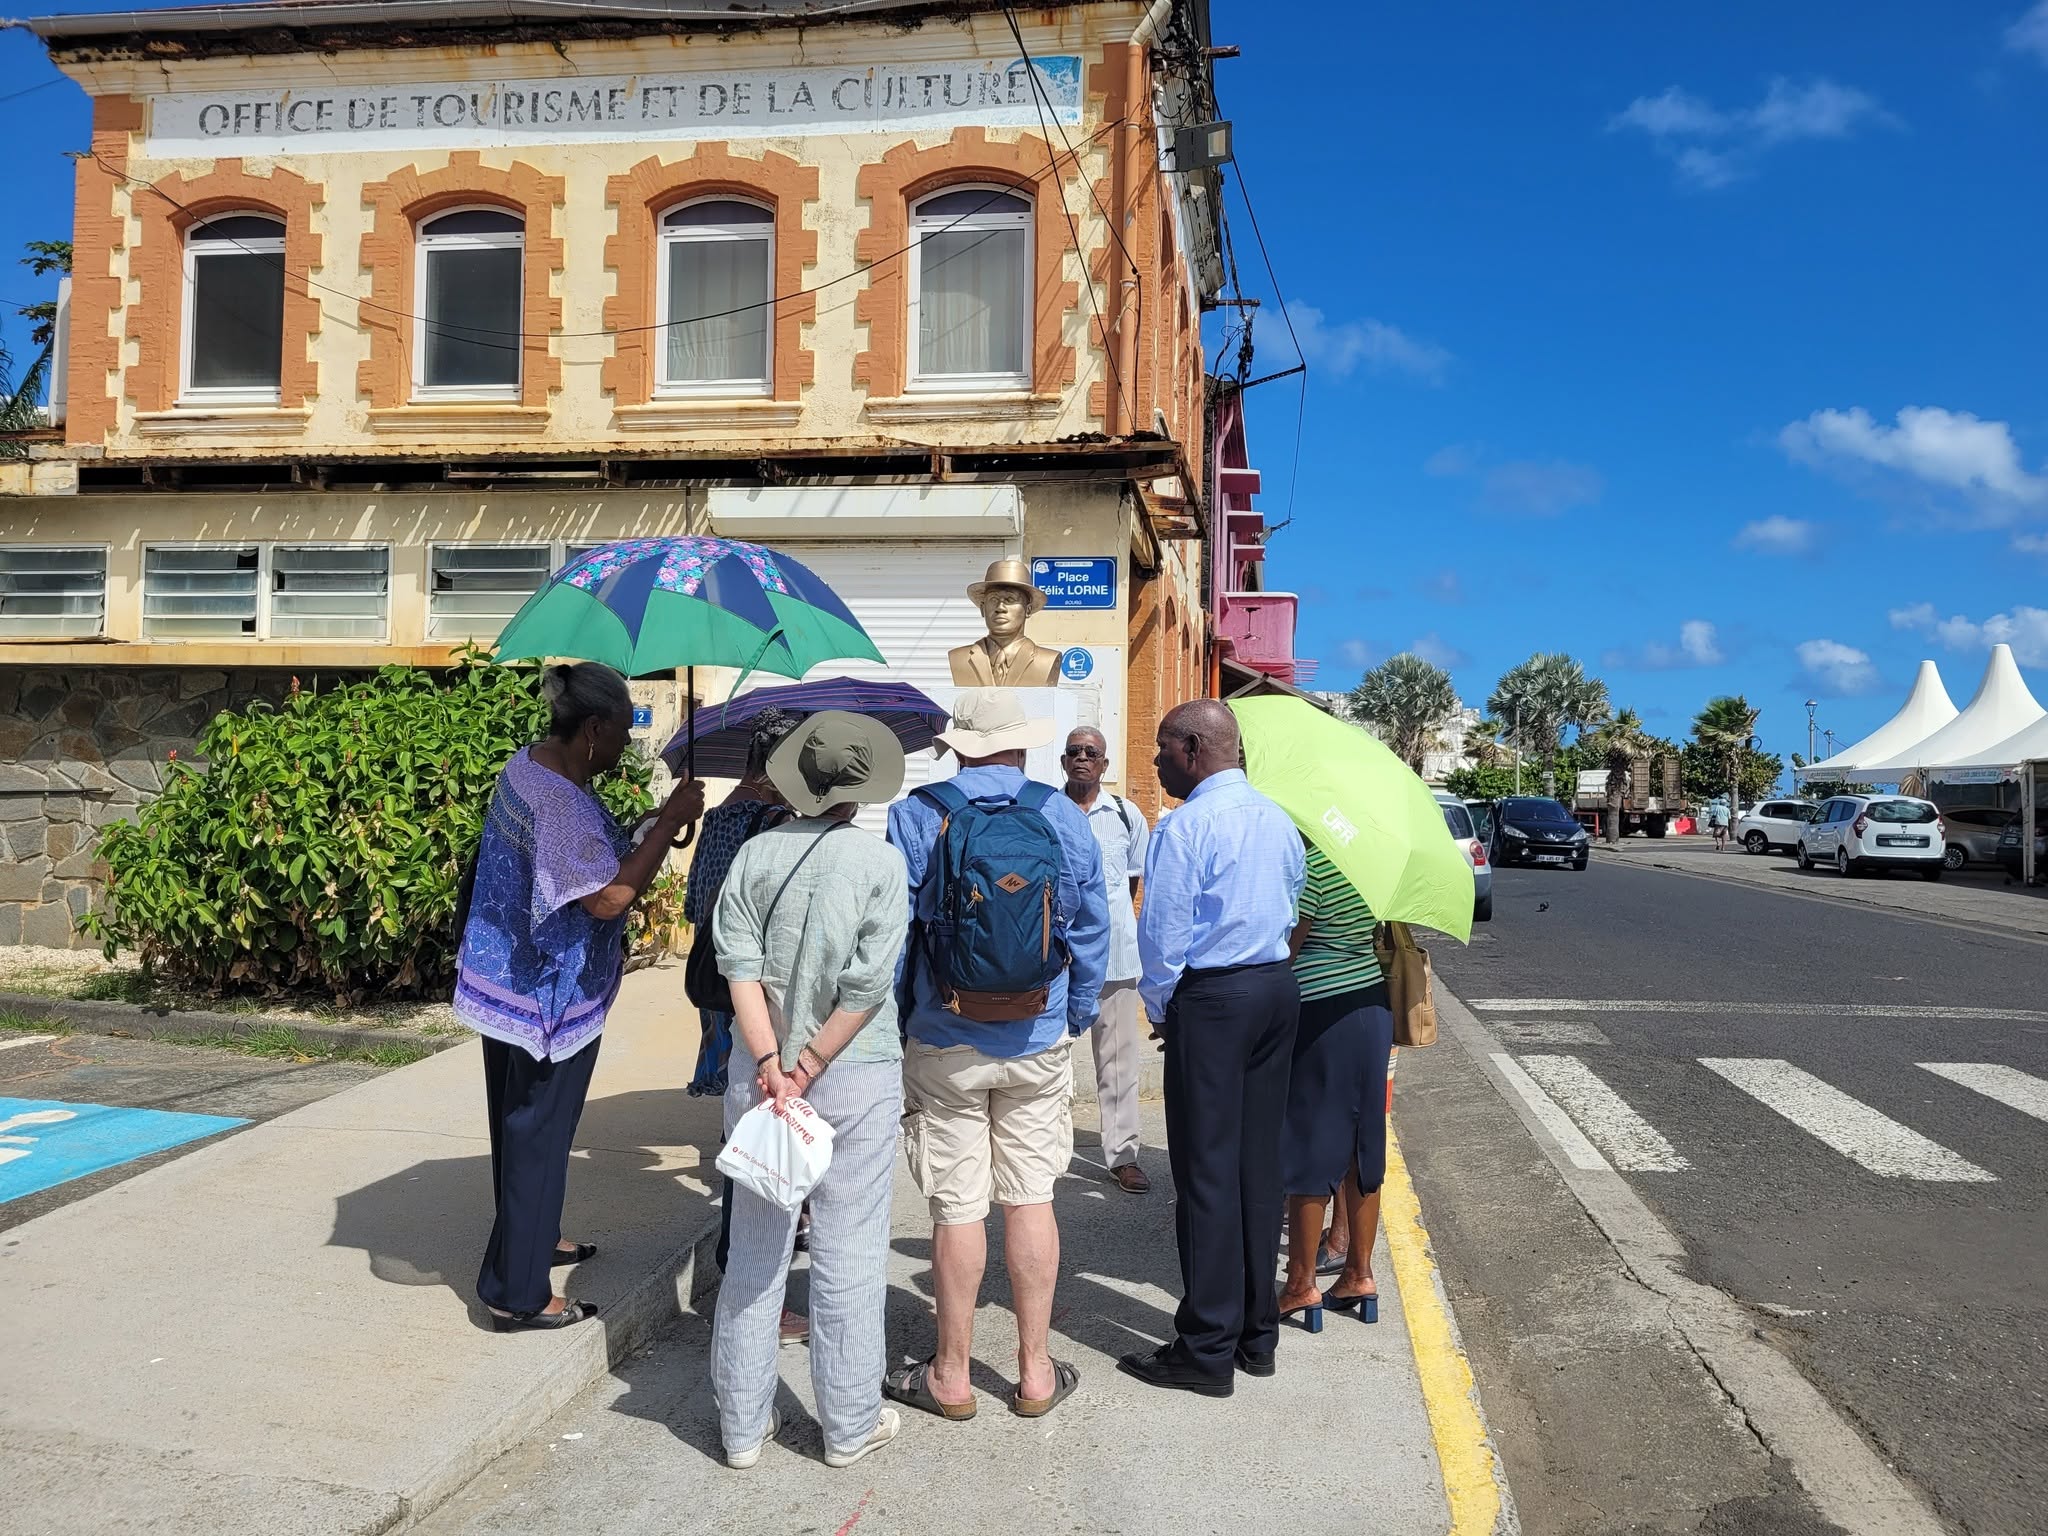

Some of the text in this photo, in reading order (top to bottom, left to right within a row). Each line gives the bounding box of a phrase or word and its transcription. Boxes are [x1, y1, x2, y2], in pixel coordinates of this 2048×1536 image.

[198, 70, 1027, 136] OFFICE DE TOURISME ET DE LA CULTURE
[1057, 571, 1090, 582] Place
[1038, 585, 1109, 596] Félix LORNE
[637, 711, 645, 722] 2
